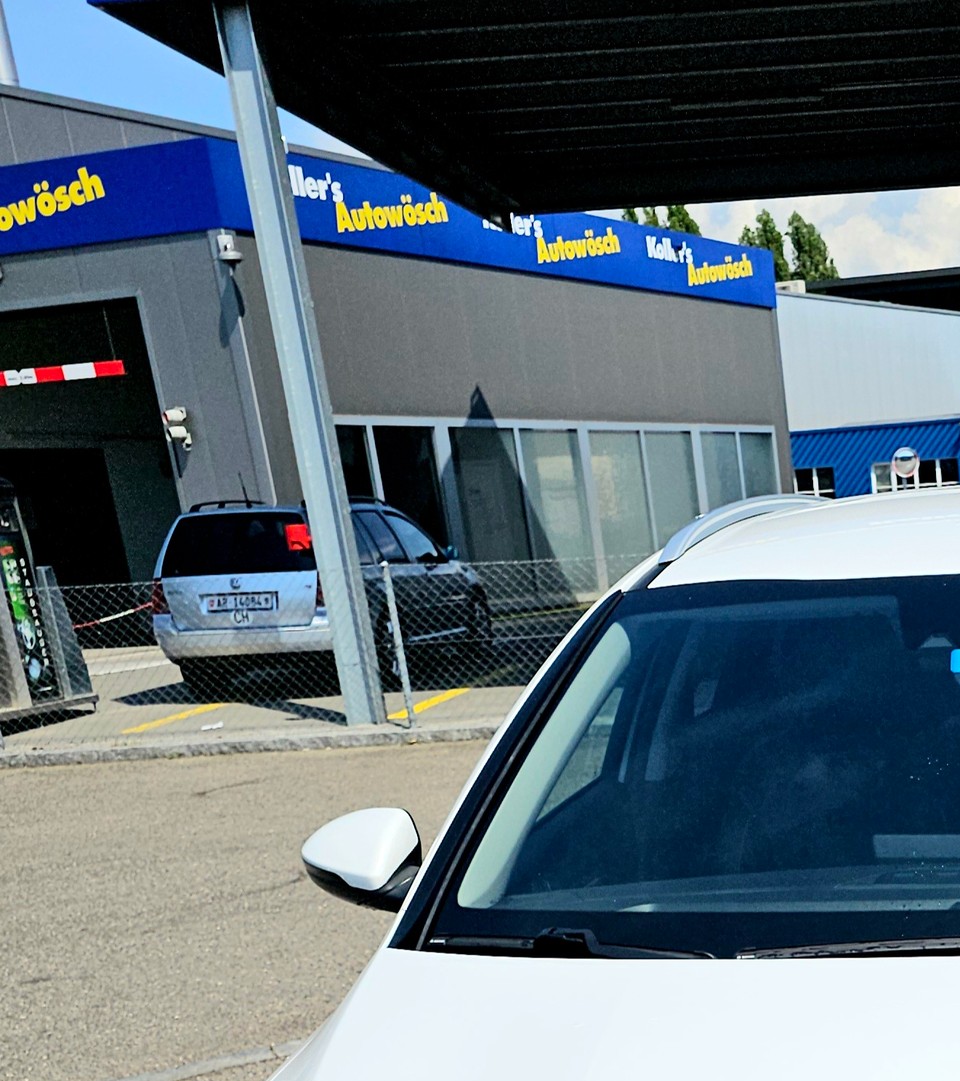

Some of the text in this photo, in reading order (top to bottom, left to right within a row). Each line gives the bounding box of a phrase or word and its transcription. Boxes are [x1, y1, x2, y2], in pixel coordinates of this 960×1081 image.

[287, 164, 344, 203] ller's
[335, 191, 449, 233] Autowösch
[536, 227, 621, 264] Autowösch
[687, 253, 753, 287] Autowösch
[233, 610, 250, 624] CH
